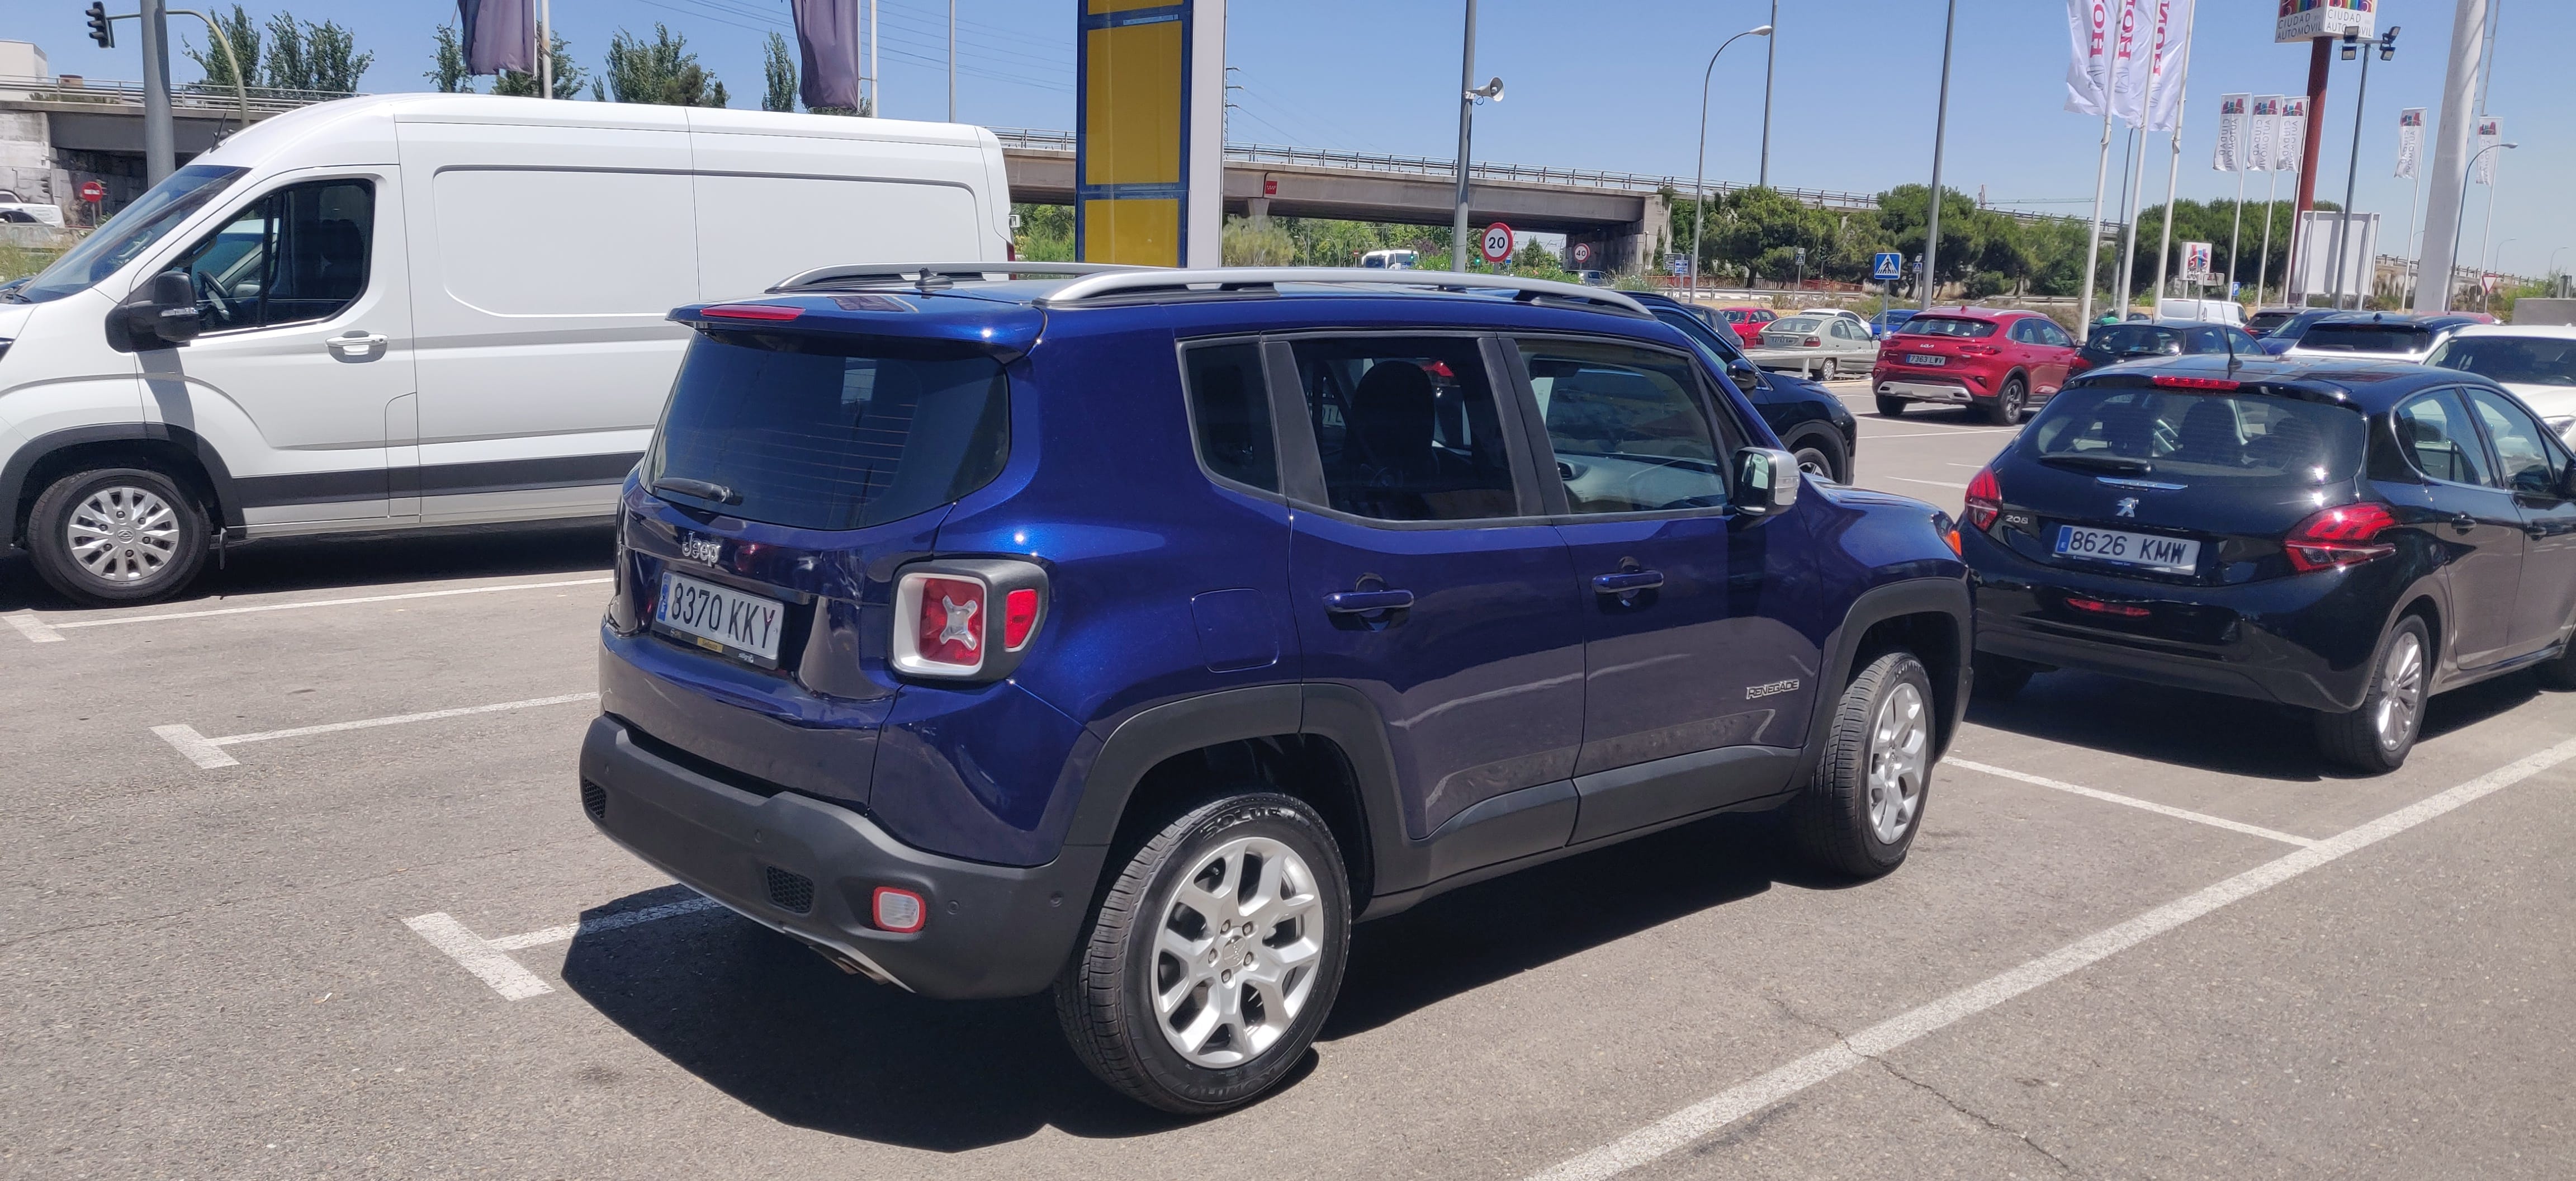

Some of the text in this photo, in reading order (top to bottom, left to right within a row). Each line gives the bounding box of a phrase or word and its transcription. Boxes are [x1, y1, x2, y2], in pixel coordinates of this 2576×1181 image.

[2278, 13, 2311, 29] CIUDAD
[2328, 9, 2361, 23] CIUDAD
[2277, 21, 2322, 40] AUTOMÓVIL
[1488, 237, 1505, 249] 20
[2233, 284, 2239, 294] P
[1911, 355, 1928, 363] 7363
[2006, 515, 2029, 524] 208
[682, 531, 721, 568] Jeep
[2070, 531, 2187, 565] 8626 KMW
[671, 582, 776, 649] 8370 KKY
[1746, 679, 1800, 700] RENEGADE
